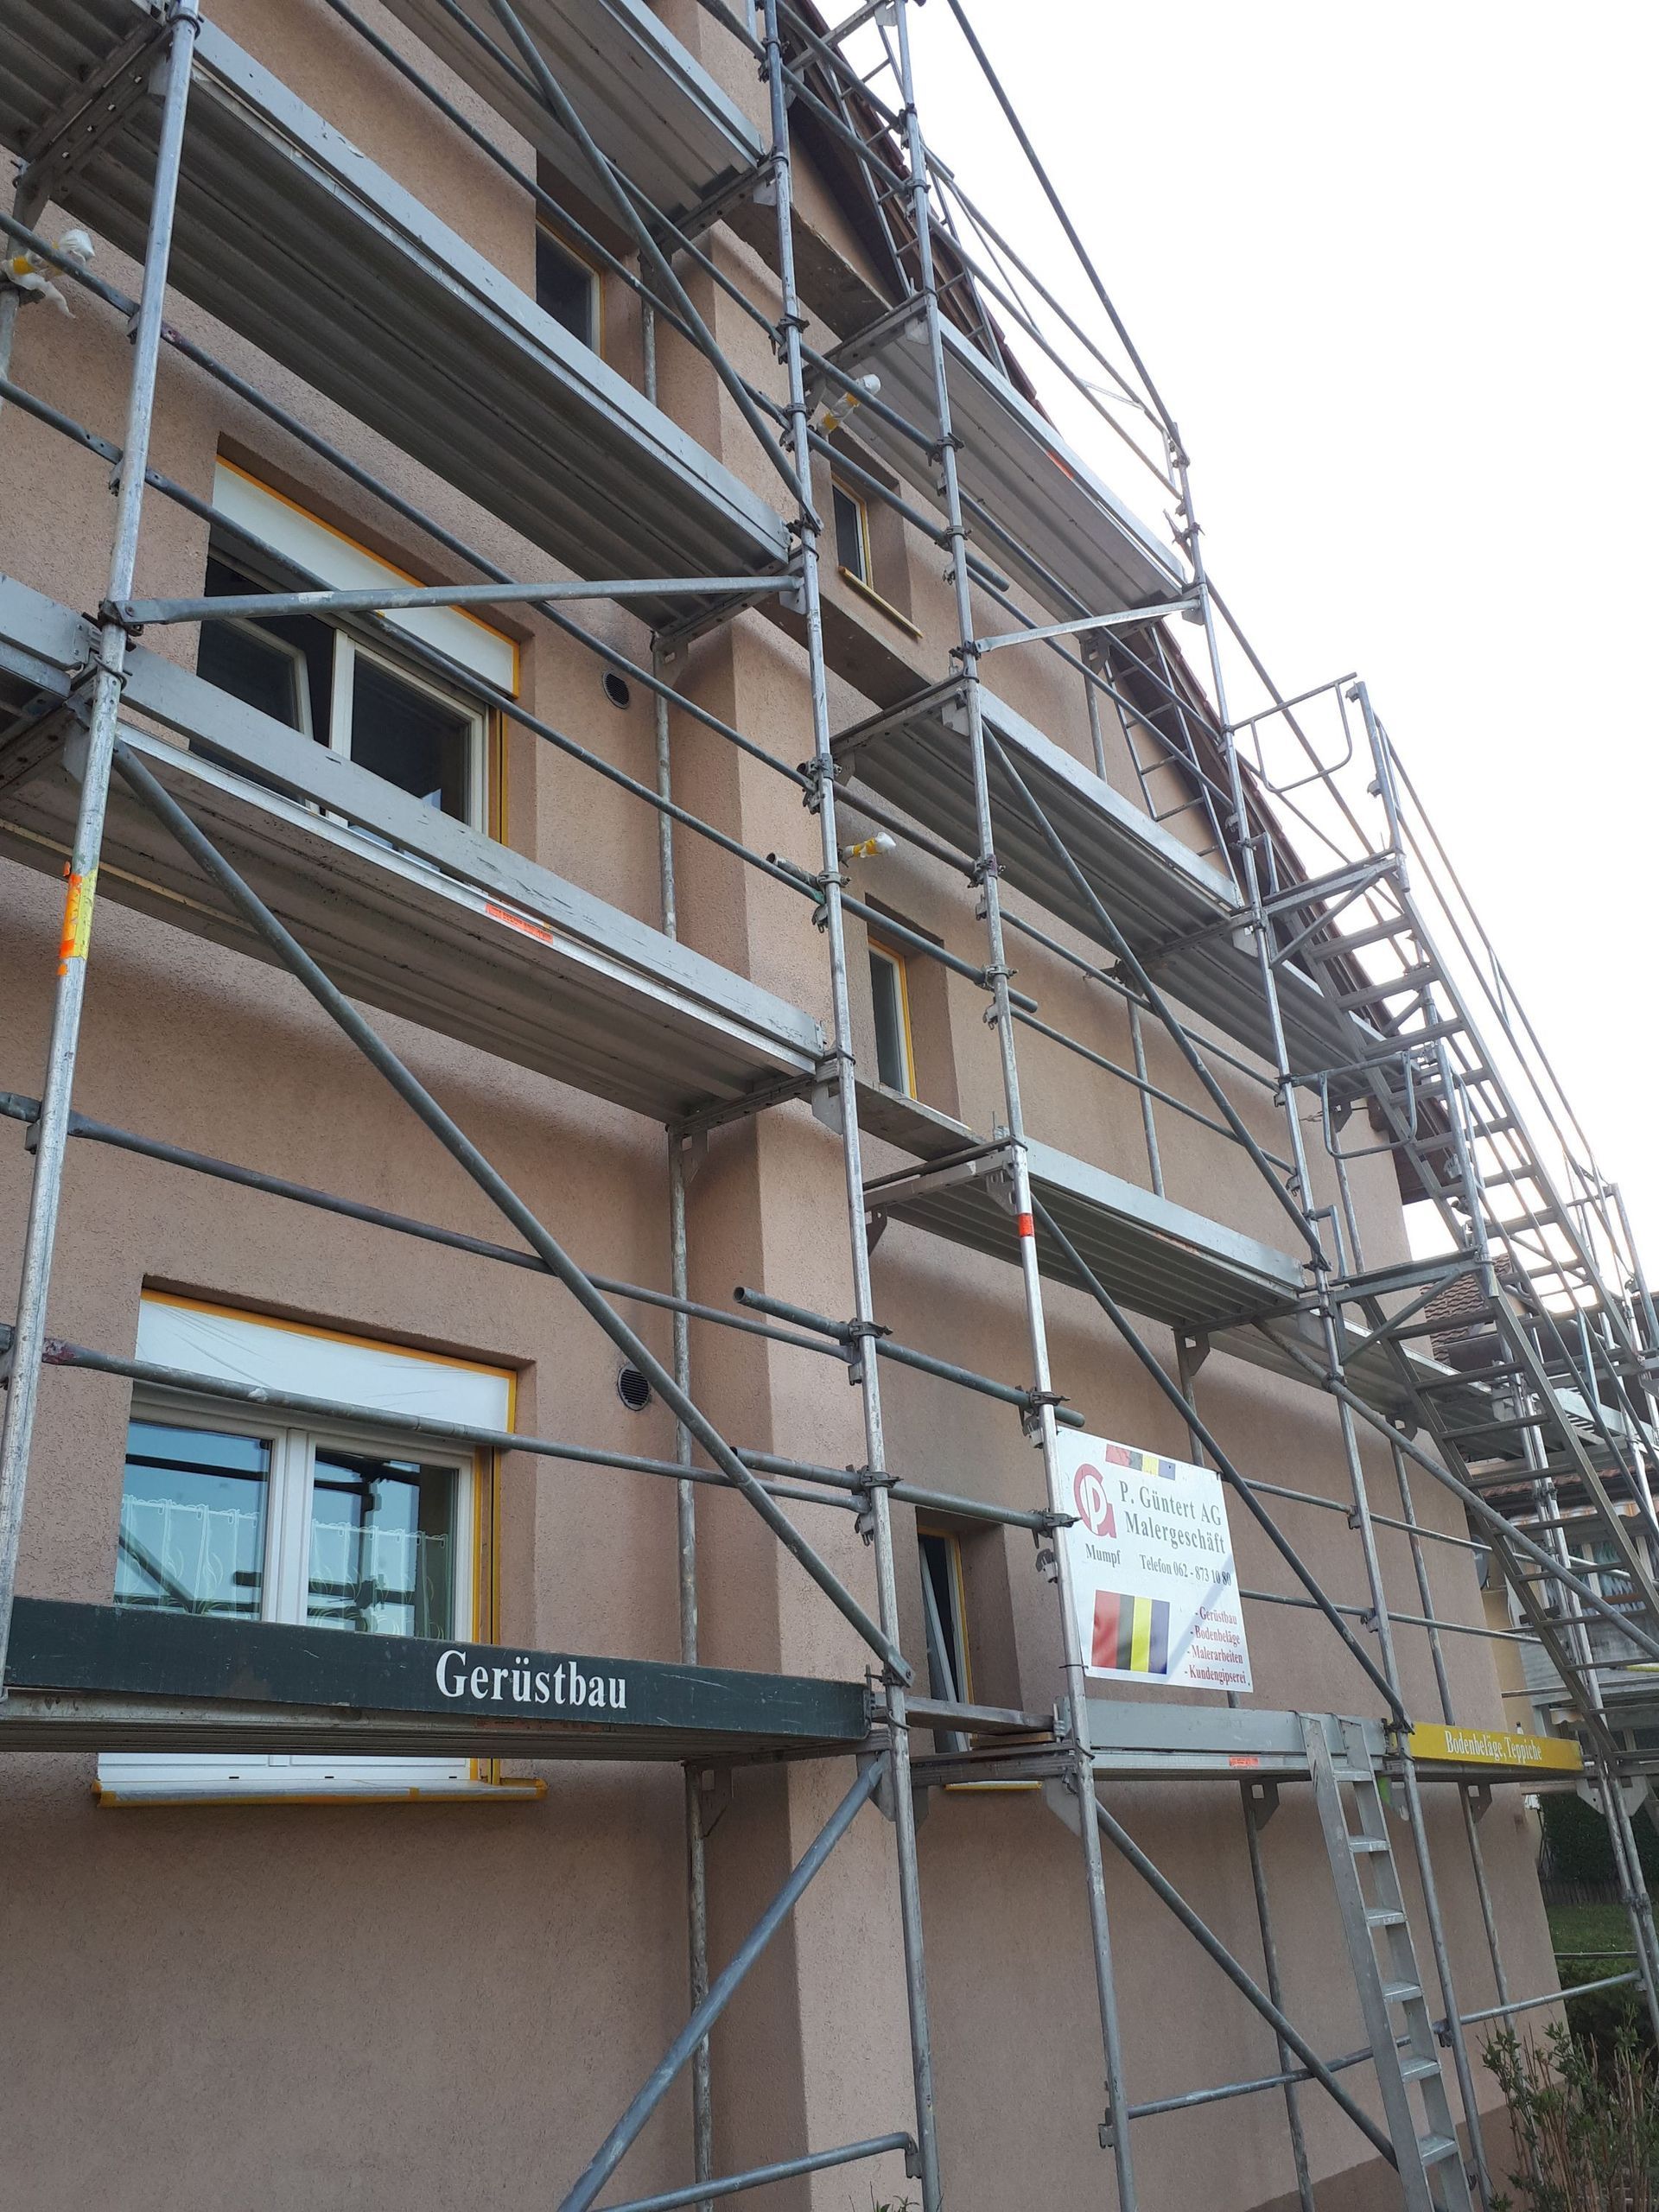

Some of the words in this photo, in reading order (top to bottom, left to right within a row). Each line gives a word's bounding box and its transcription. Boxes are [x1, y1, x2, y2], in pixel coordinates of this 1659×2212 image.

[1118, 1479, 1135, 1504] P.
[1140, 1485, 1196, 1520] Güntert
[1201, 1502, 1222, 1527] AG
[1123, 1510, 1226, 1554] Malergeschäft
[1084, 1542, 1122, 1568] Mumpf
[1139, 1554, 1173, 1575] Telefon
[1173, 1561, 1189, 1579] 062
[1194, 1565, 1210, 1582] 873
[1211, 1568, 1221, 1585] 10
[1221, 1571, 1232, 1586] 80
[1199, 1605, 1238, 1625] Gerüstbau
[1194, 1624, 1241, 1648] Bodenbeläge
[1191, 1644, 1243, 1664] Malerarbeiten
[435, 1649, 627, 1709] Gerüstbau
[1188, 1664, 1247, 1686] Kundengipserei
[1444, 1730, 1507, 1762] Bodenbeläge,
[1503, 1736, 1542, 1764] Teppiche
